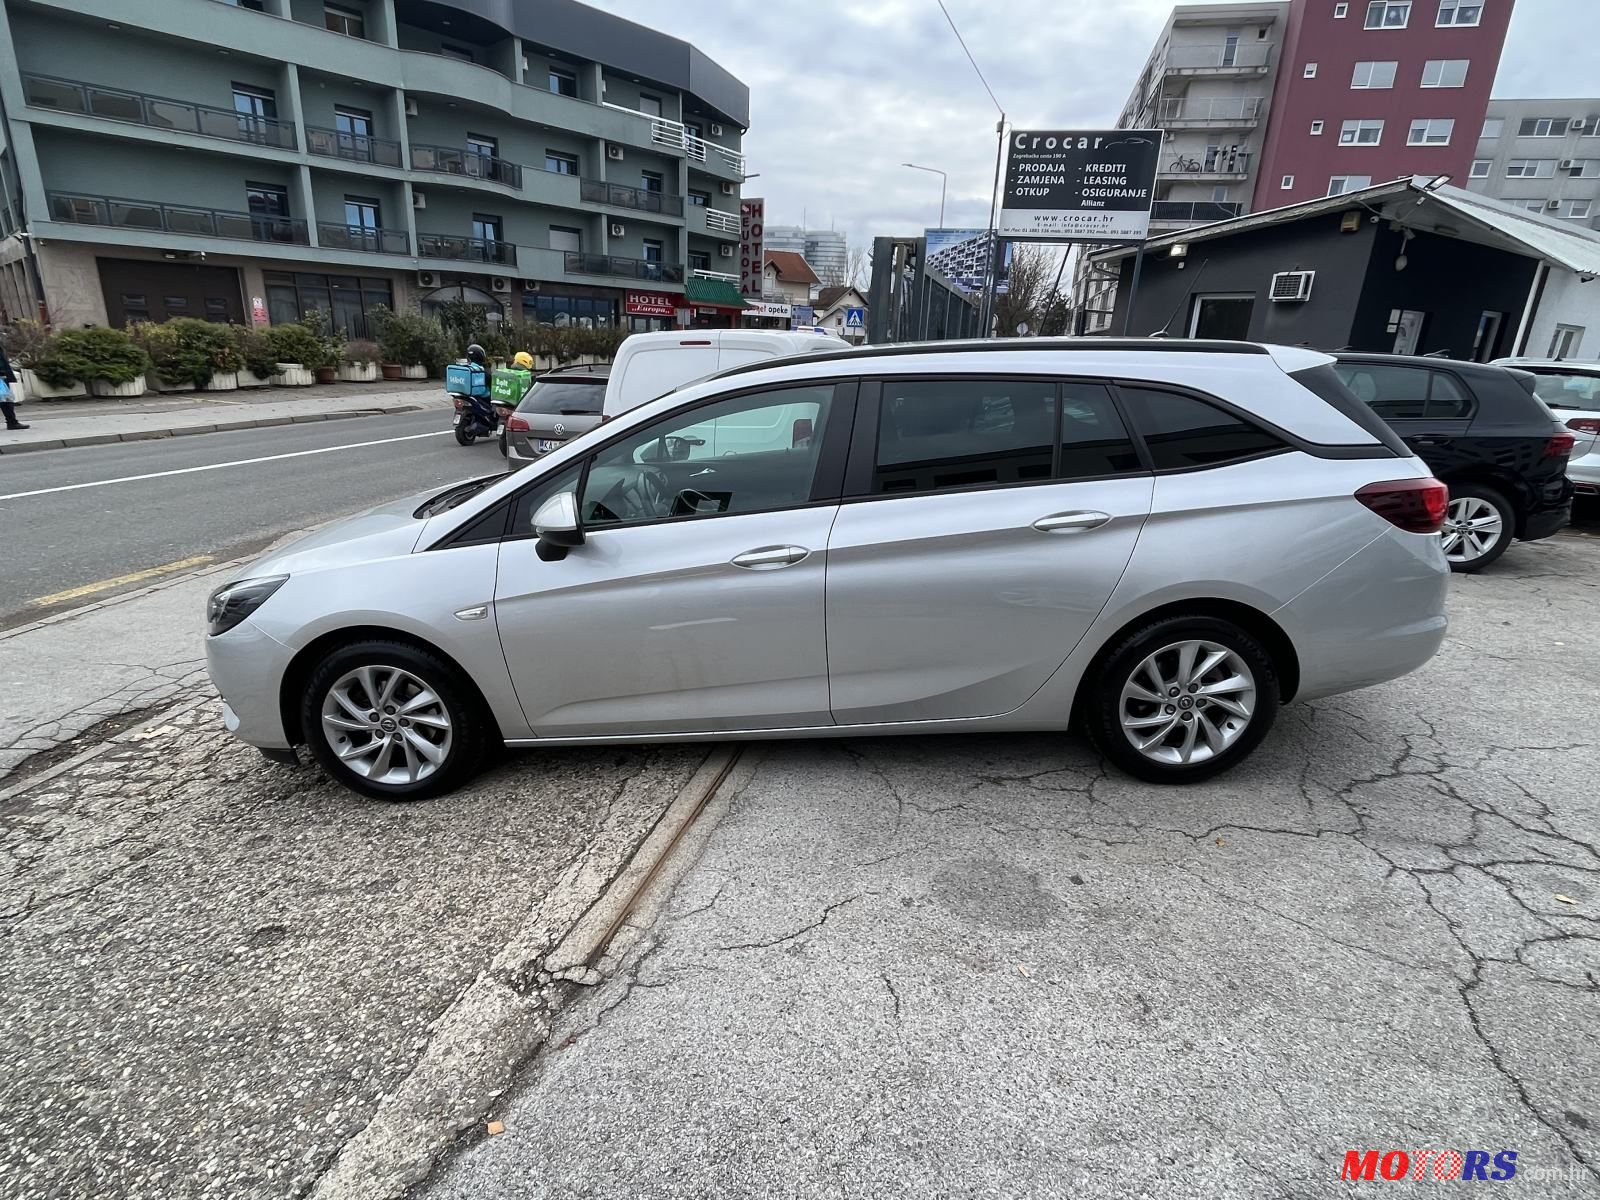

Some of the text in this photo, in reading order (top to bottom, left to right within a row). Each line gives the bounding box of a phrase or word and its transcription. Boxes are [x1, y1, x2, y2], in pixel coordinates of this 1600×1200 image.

[1014, 133, 1103, 149] Crocar
[1018, 163, 1066, 173] PRODAJA
[1085, 163, 1127, 173] KREDITI
[1016, 175, 1065, 185] ZAMJENA
[1083, 175, 1127, 186] LEASING
[1015, 187, 1050, 197] OTKUP
[1081, 188, 1148, 198] OSIGURANJE
[1080, 199, 1105, 207] Allianz
[1034, 214, 1115, 223] www.crocar.hr
[750, 203, 763, 294] HOTEL
[741, 217, 750, 295] EUROPA
[629, 294, 672, 306] HOTEL
[768, 306, 788, 315] opeke
[495, 386, 511, 396] Food
